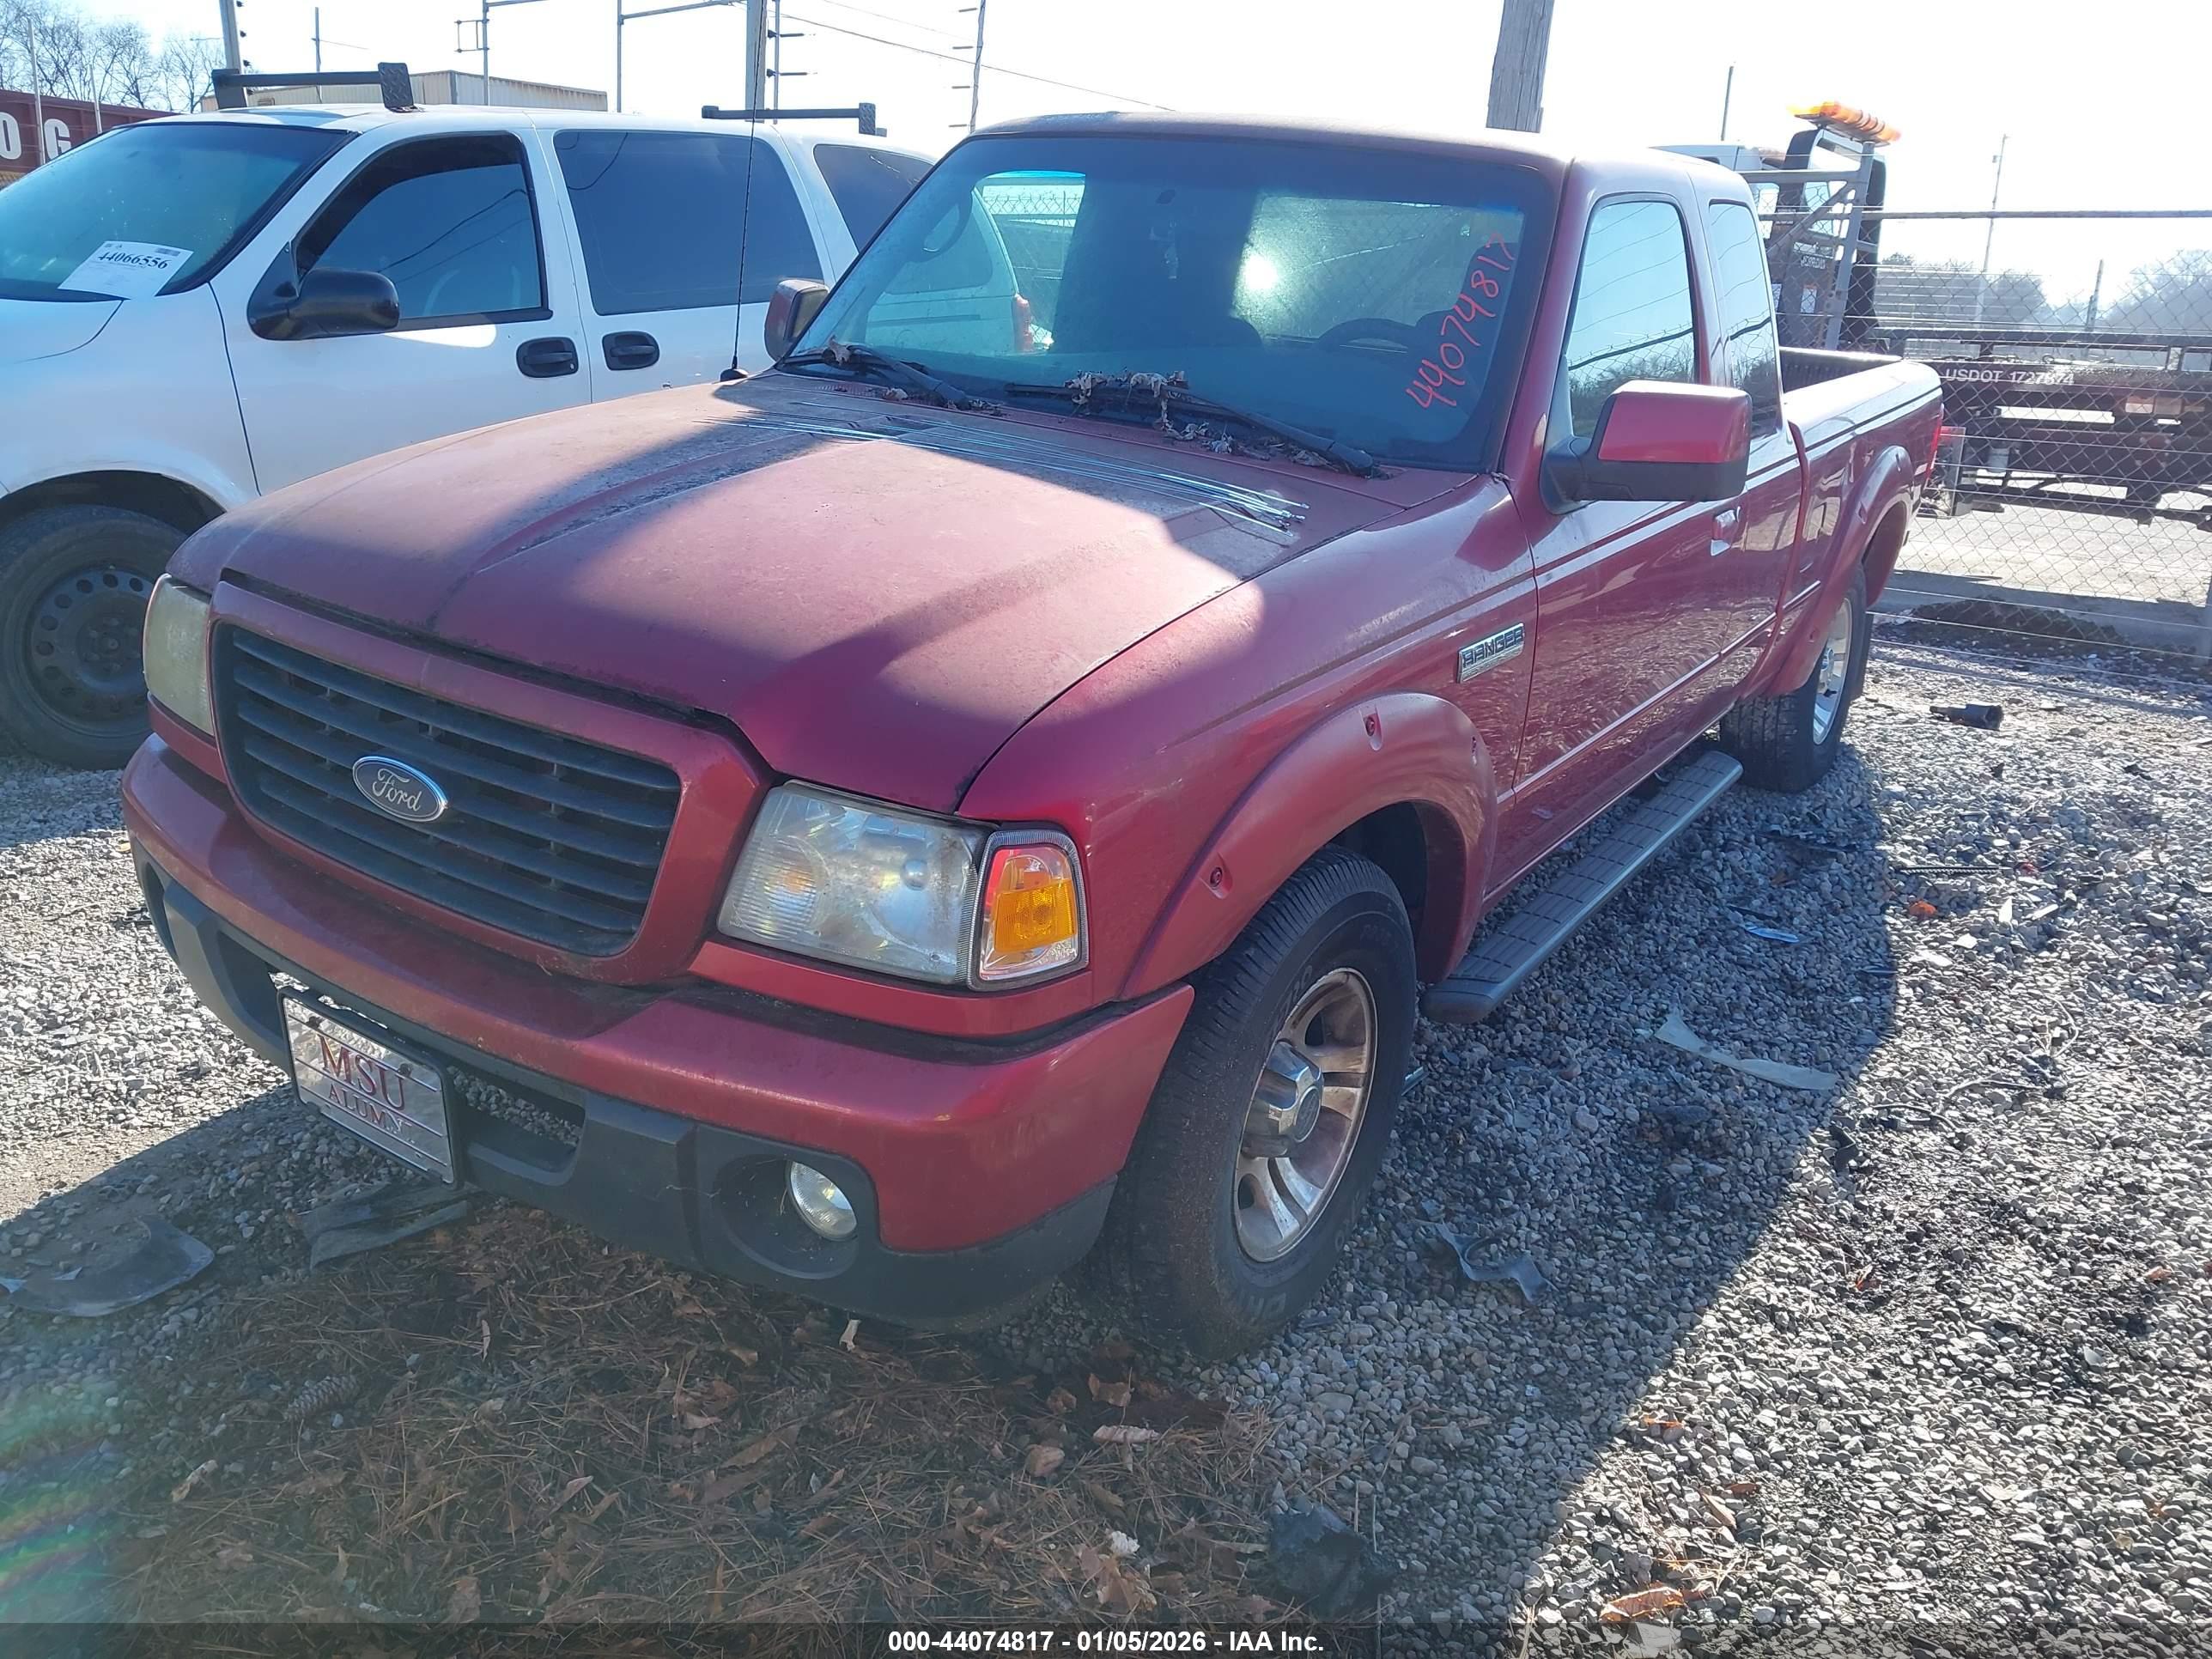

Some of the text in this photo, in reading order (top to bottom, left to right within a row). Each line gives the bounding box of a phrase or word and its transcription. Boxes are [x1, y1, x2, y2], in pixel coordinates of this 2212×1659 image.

[98, 251, 172, 270] 44066556
[1406, 233, 1515, 408] 44074817
[1946, 368, 2003, 383] USDOT
[372, 768, 422, 811] Ford
[316, 1030, 405, 1110] MSU
